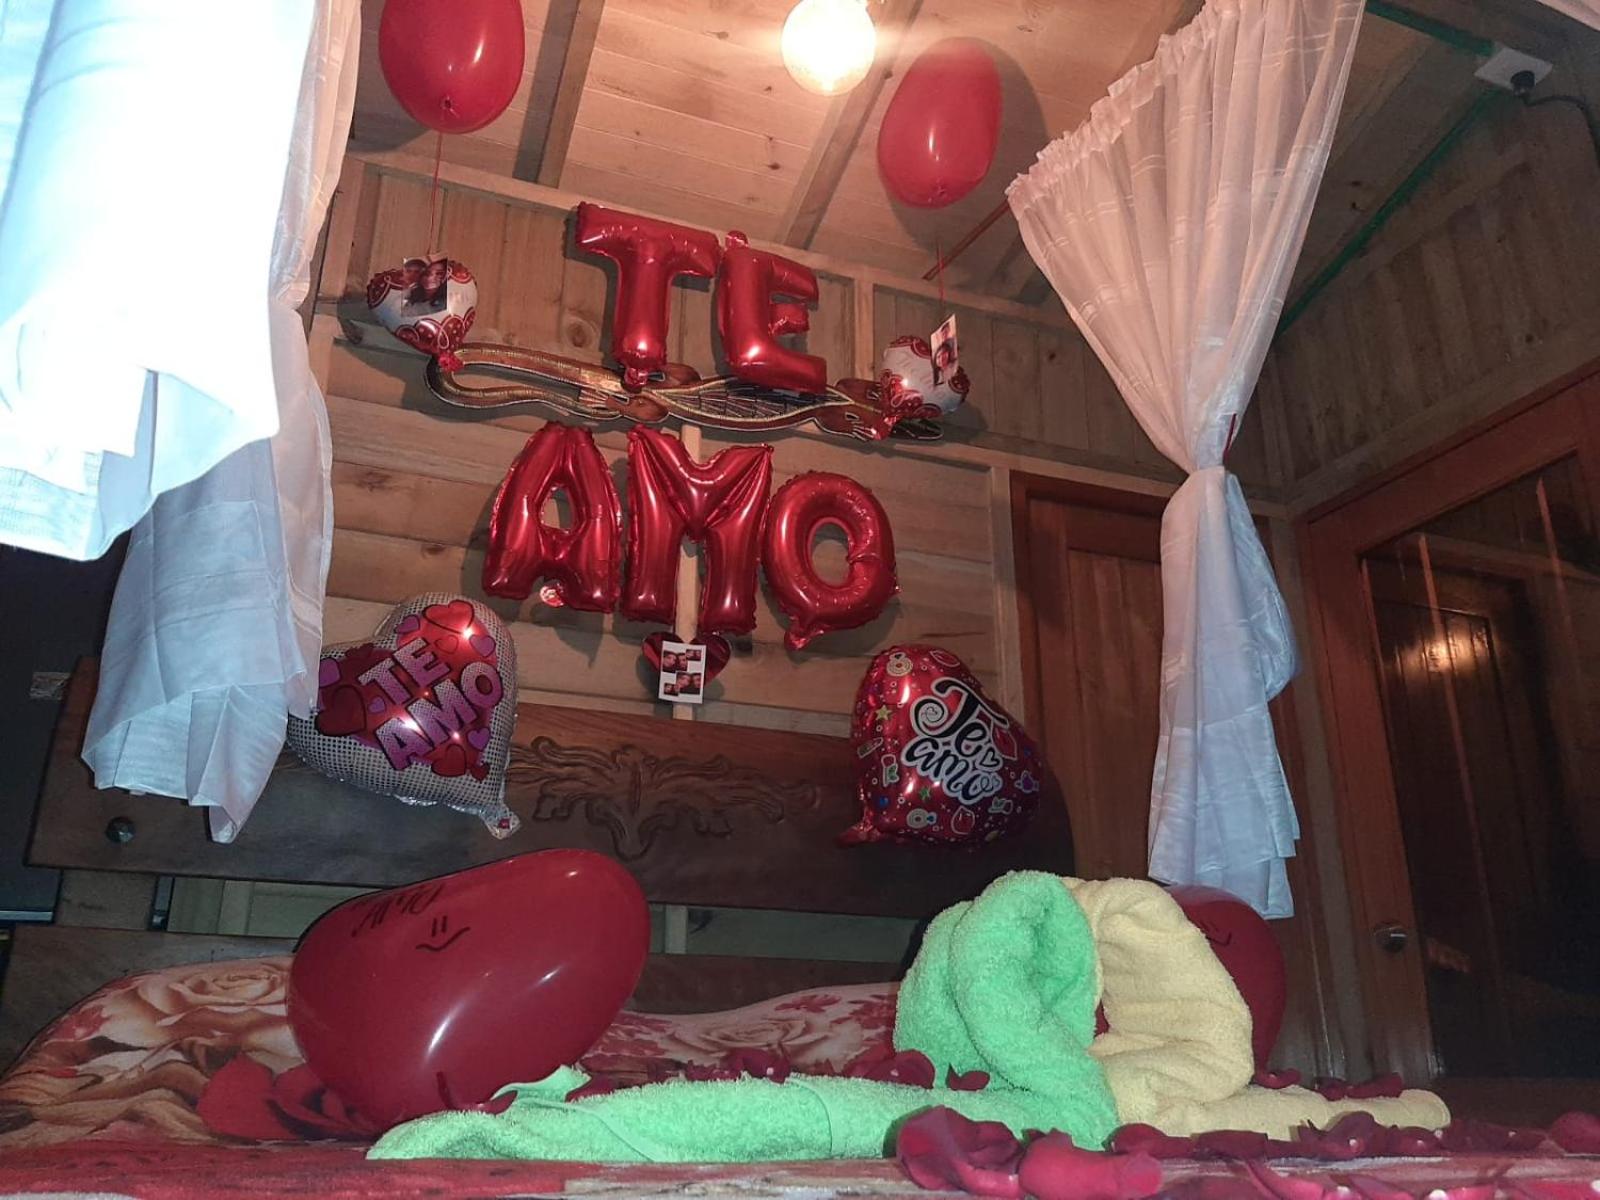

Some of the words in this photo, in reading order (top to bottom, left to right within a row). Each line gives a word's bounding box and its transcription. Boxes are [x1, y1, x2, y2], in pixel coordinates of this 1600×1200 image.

[577, 202, 827, 393] TE
[482, 421, 897, 648] AMO
[358, 637, 450, 705] TE
[375, 662, 503, 770] AMO
[911, 677, 1009, 757] Te
[903, 736, 1001, 804] amo
